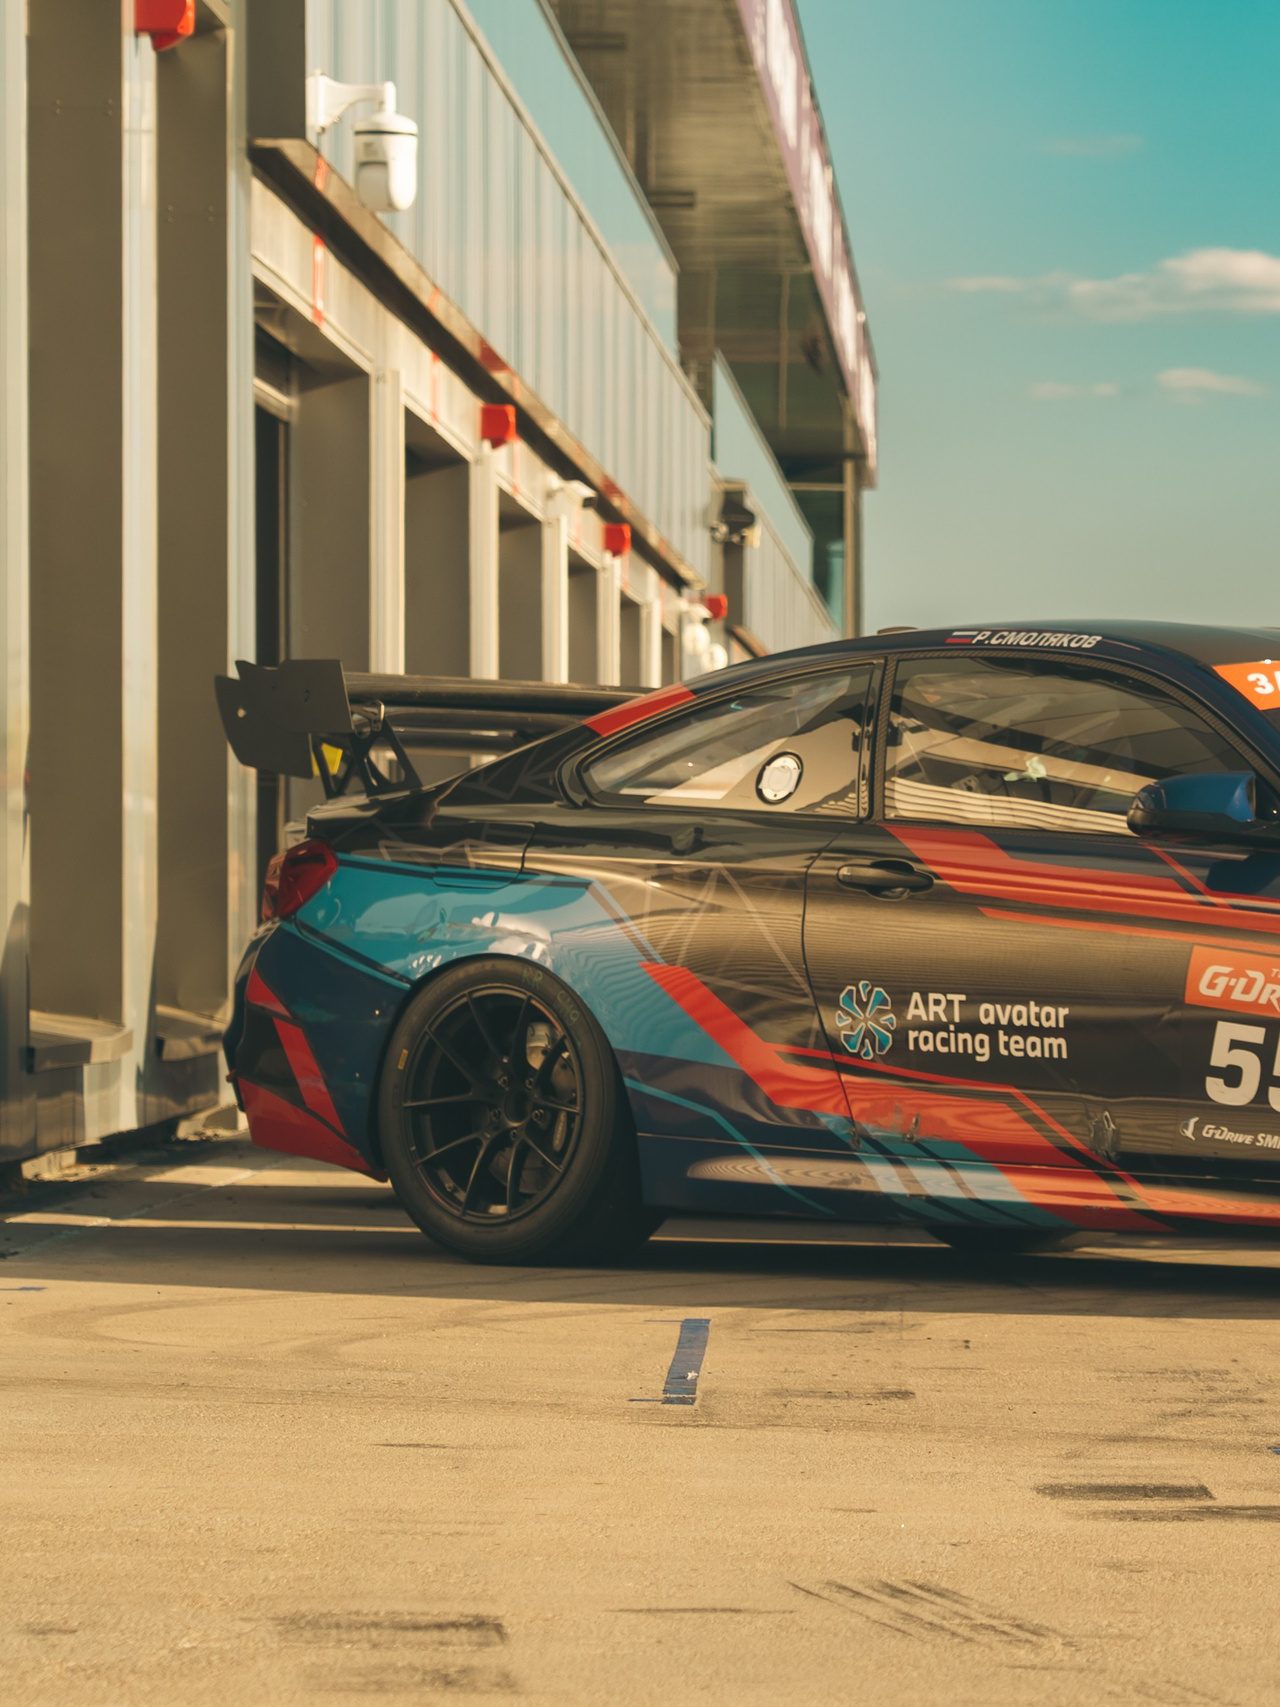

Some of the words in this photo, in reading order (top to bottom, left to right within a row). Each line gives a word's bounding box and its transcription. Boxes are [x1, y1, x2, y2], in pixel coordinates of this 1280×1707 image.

[971, 631, 1102, 649] Р.СМОЛЯКОВ
[906, 992, 967, 1022] ART
[979, 1001, 1069, 1028] avatar
[908, 1024, 990, 1062] racing
[998, 1029, 1068, 1059] team
